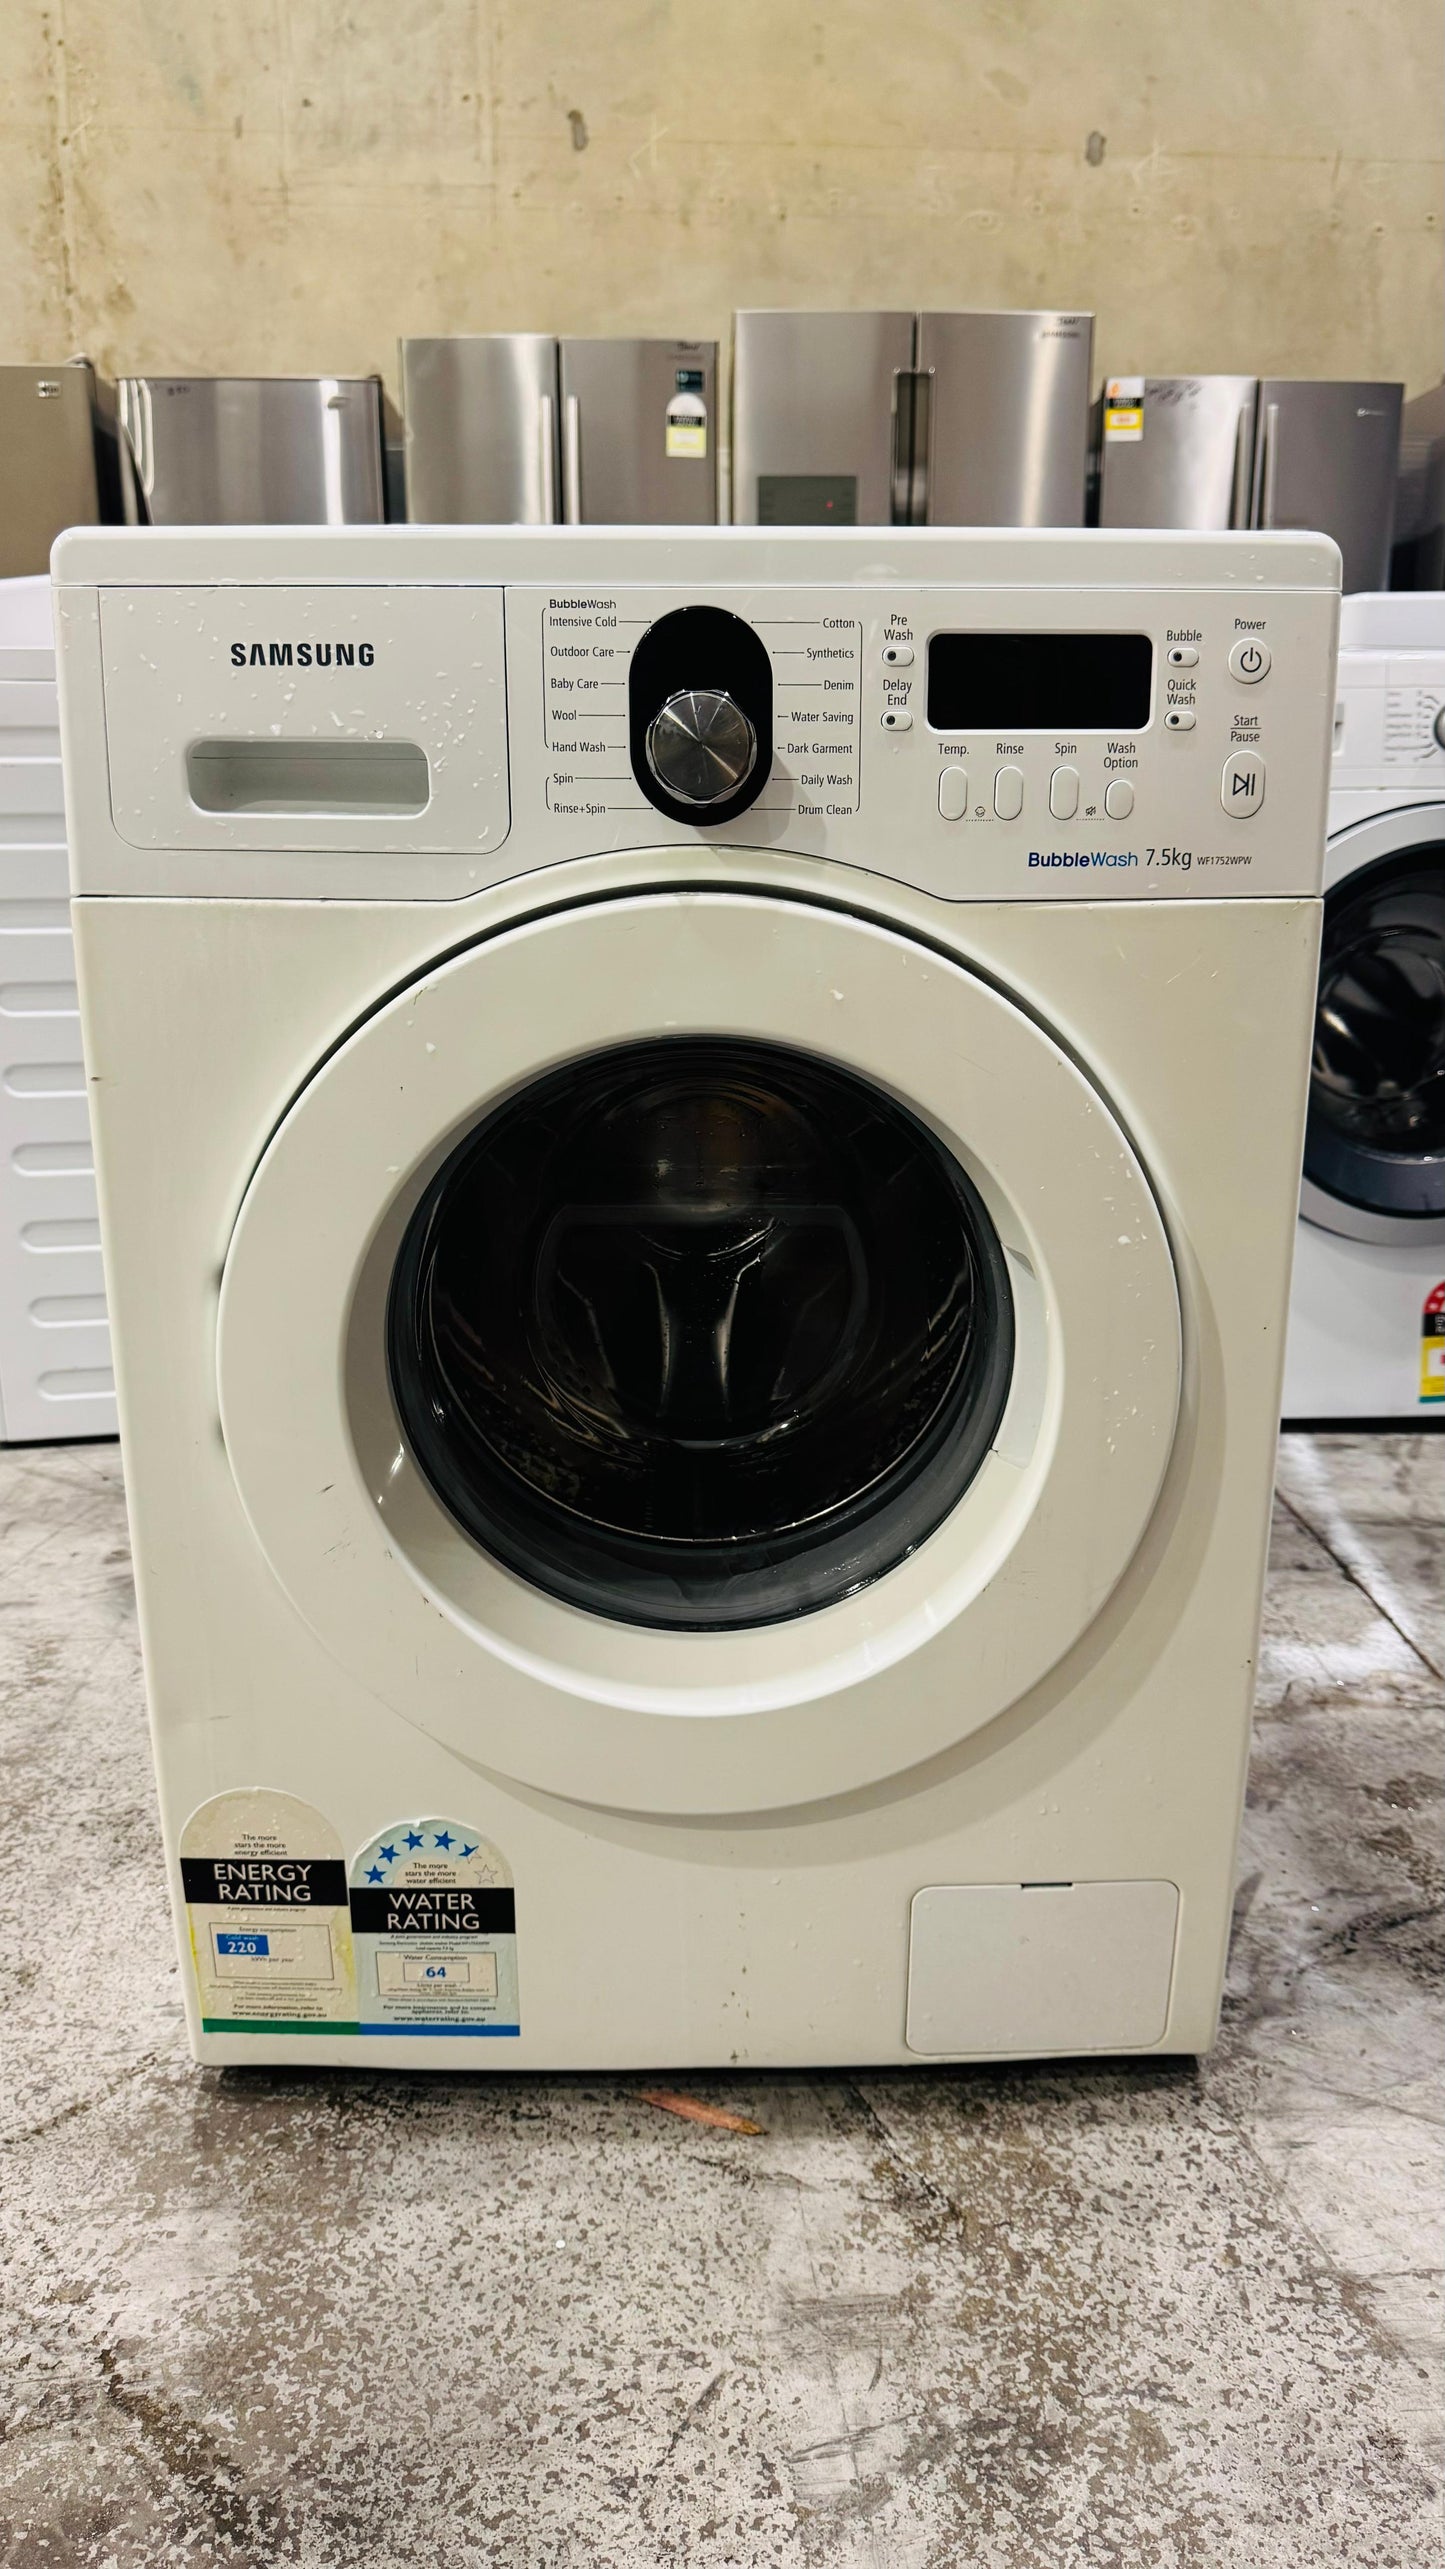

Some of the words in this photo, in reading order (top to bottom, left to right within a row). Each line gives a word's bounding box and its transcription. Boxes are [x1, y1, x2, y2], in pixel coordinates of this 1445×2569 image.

[549, 599, 617, 609] BubbleWash
[549, 617, 592, 627] Intensive
[595, 617, 617, 627] Cold
[823, 618, 855, 629] Cotton
[890, 614, 907, 626] Pre
[1234, 619, 1266, 631] Power
[884, 629, 913, 641] Wash
[1166, 630, 1202, 642] Bubble
[231, 643, 375, 667] SAMSUNG
[550, 647, 589, 657] Outdoor
[592, 647, 614, 657] Care
[806, 648, 855, 660] Synthetics
[551, 679, 574, 691] Baby
[577, 679, 599, 689] Care
[824, 680, 854, 690] Denim
[883, 679, 912, 694] Delay
[1167, 679, 1197, 691] Quick
[887, 694, 907, 706] End
[1167, 693, 1195, 705] Wash
[552, 710, 577, 720] Wool
[791, 712, 819, 722] Water
[822, 712, 854, 725] Saving
[1234, 715, 1258, 726] Start
[1230, 731, 1260, 742] Pause
[552, 742, 574, 752] Hand
[576, 742, 606, 752] Wash
[787, 744, 809, 754] Dark
[812, 744, 852, 754] Garment
[938, 743, 970, 758] Temp.
[997, 743, 1024, 755] Rinse
[1055, 743, 1077, 758] Spin
[1107, 743, 1136, 754] Wash
[1103, 757, 1138, 771] Option
[553, 774, 573, 786] Spin
[801, 775, 824, 788] Daily
[827, 775, 852, 785] Wash
[554, 804, 606, 817] Rinse+Spin
[798, 805, 823, 815] Drum
[826, 805, 852, 815] Clean
[1028, 852, 1138, 868] BubbleWash
[1145, 849, 1192, 870] 7.5kg
[1197, 856, 1252, 865] WF1752WPW
[214, 1864, 311, 1881] ENERGY
[218, 1884, 311, 1901] RATING
[389, 1894, 475, 1910] WATER
[387, 1913, 479, 1930] RATING
[228, 1942, 256, 1952] 220
[426, 1966, 447, 1978] 64
